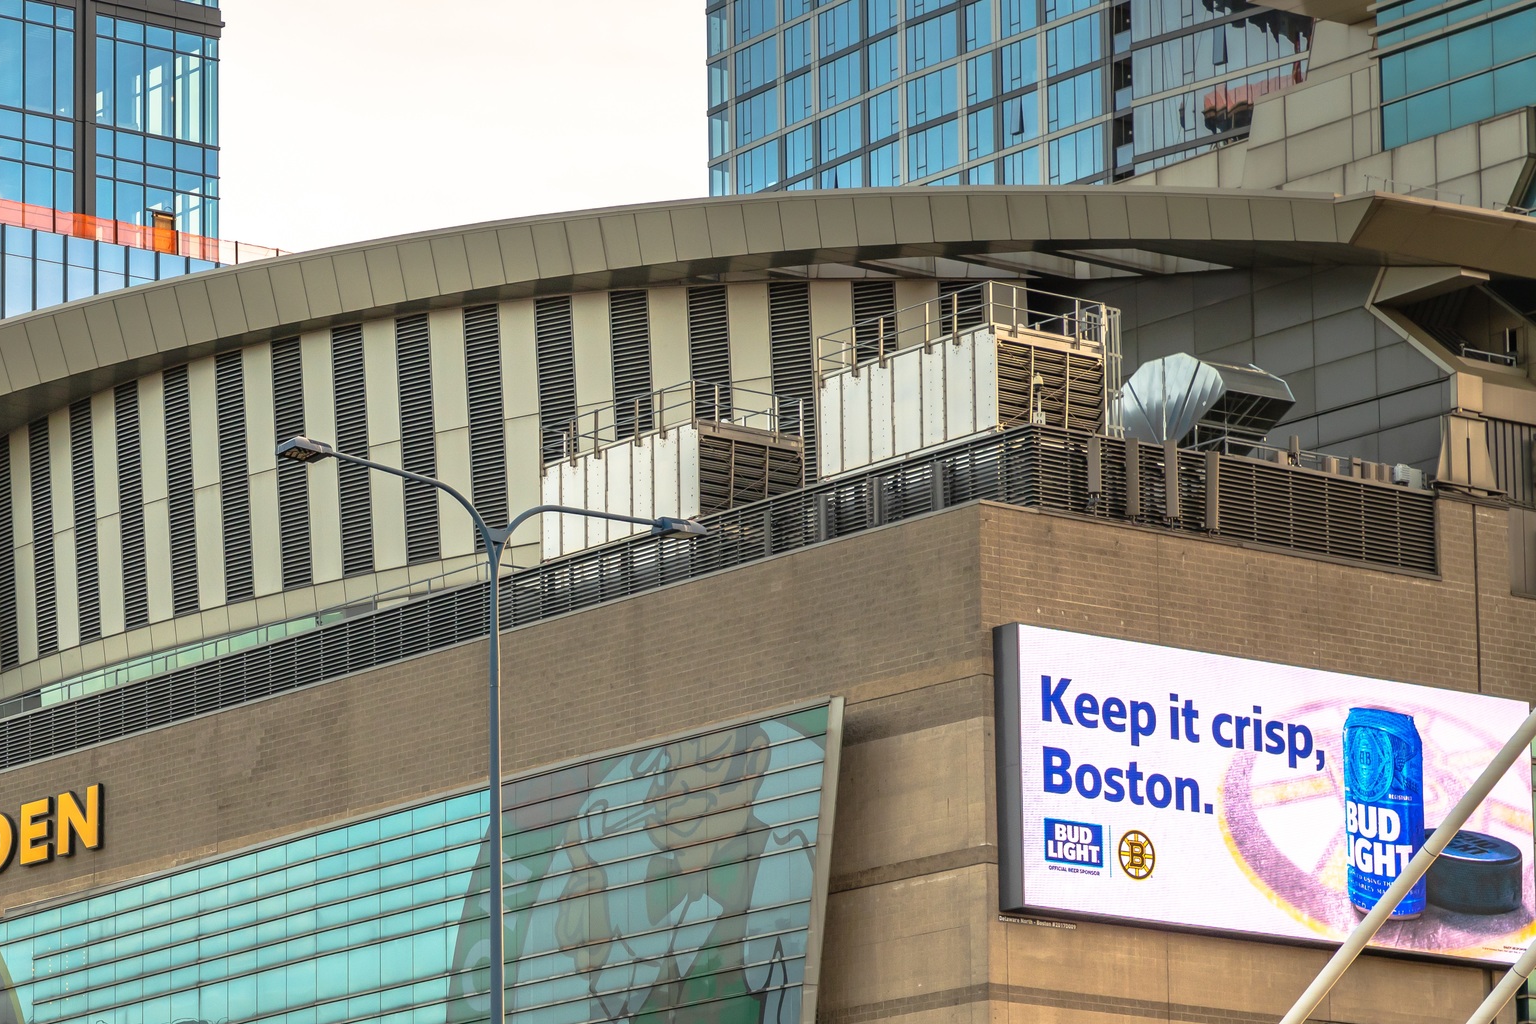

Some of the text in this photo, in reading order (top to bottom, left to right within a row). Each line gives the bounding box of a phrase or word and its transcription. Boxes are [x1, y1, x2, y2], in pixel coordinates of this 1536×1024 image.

[1041, 675, 1325, 771] Keep it crisp,
[1043, 746, 1213, 814] Boston.
[1054, 823, 1093, 844] BUD
[1346, 801, 1401, 842] BUD
[998, 915, 1020, 923] Delaware
